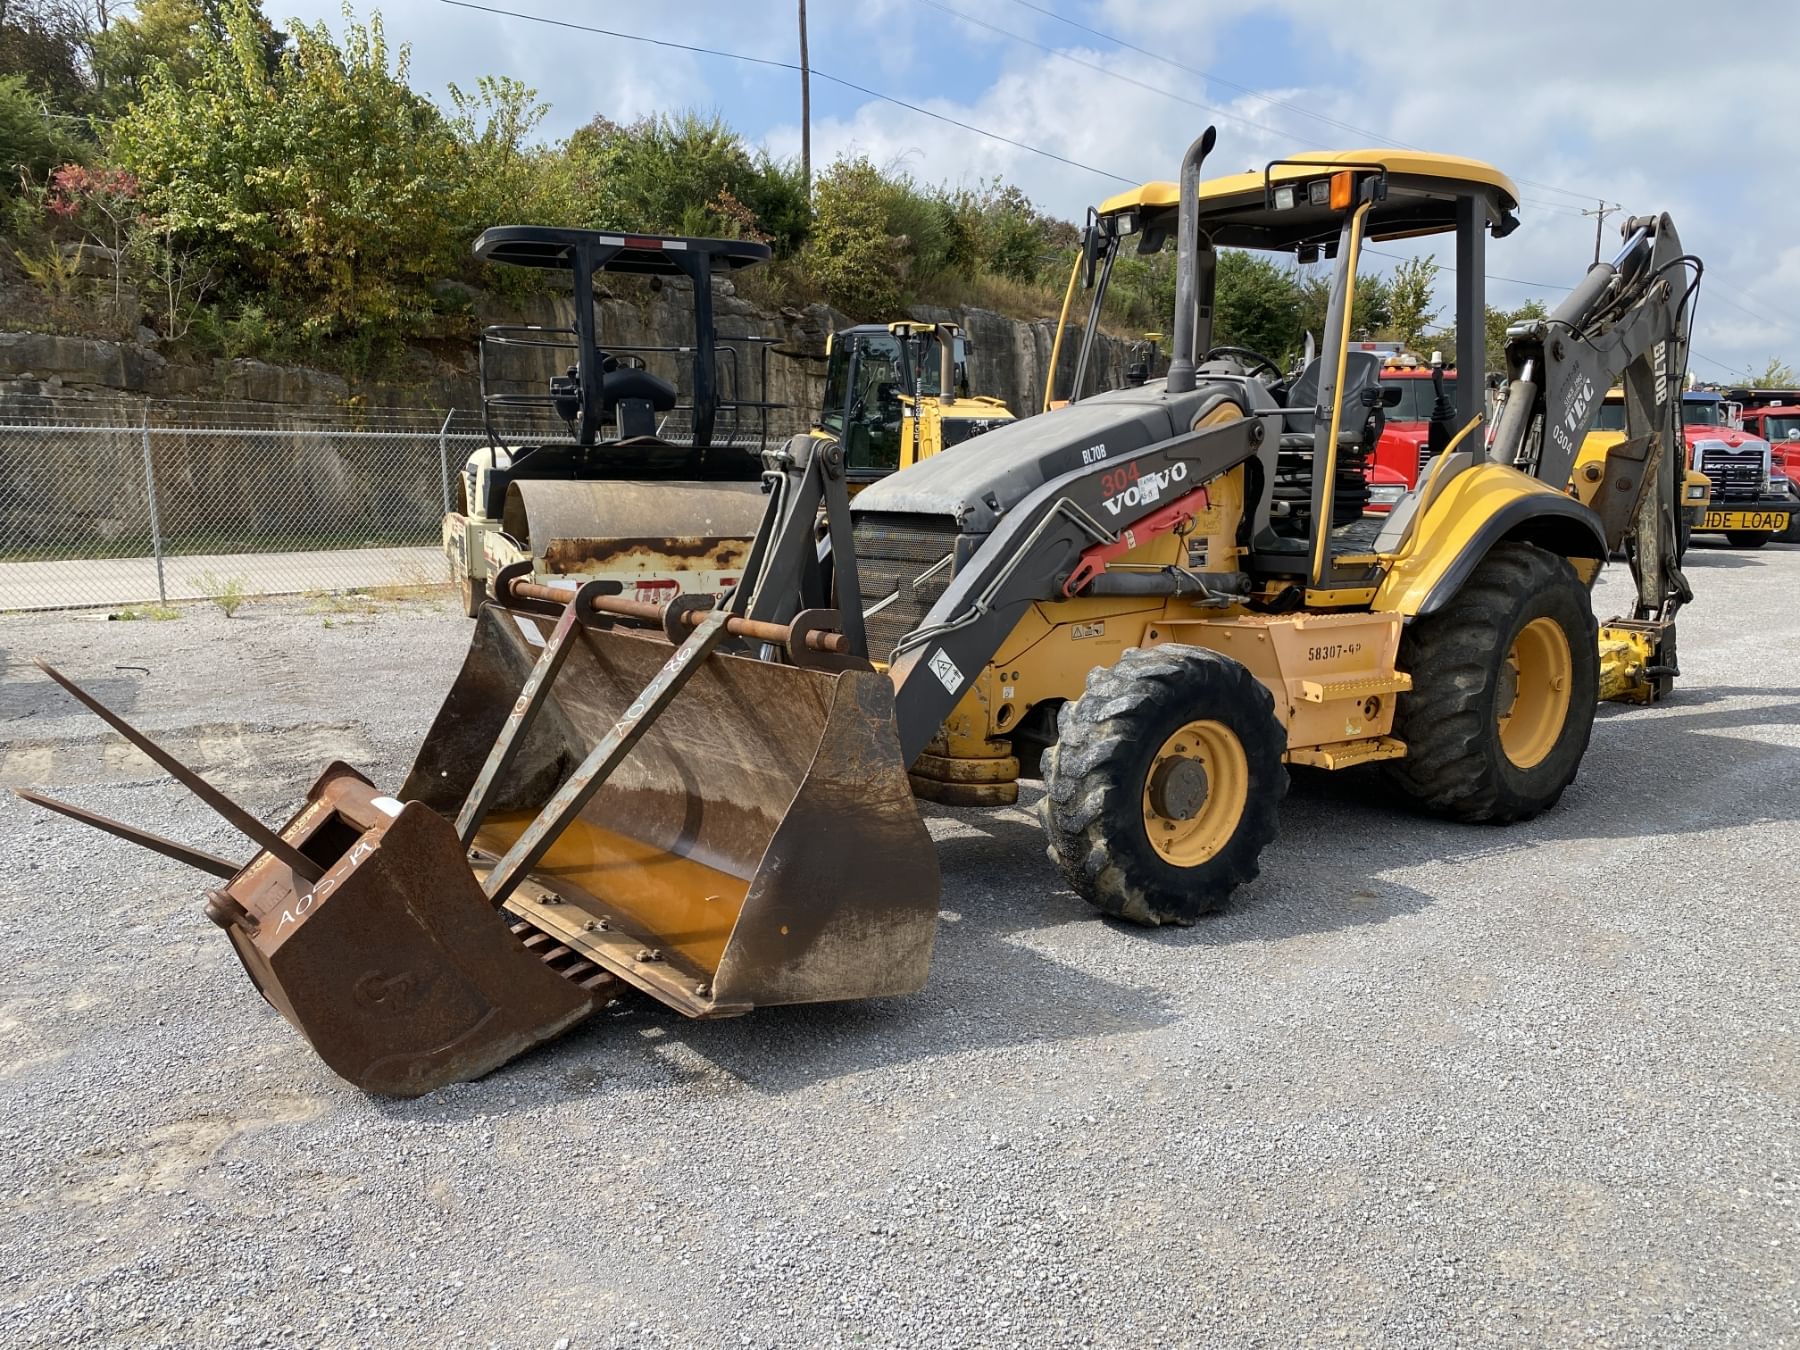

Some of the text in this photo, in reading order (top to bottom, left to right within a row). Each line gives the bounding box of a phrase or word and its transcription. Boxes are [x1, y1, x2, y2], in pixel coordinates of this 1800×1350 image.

[1653, 340, 1668, 406] BL70B
[1564, 377, 1594, 432] TEC
[1082, 443, 1107, 464] BL70B
[1553, 425, 1573, 455] 0304
[1101, 461, 1141, 497] 304
[1102, 462, 1188, 516] VOVO
[1701, 512, 1785, 529] IDE LOAD
